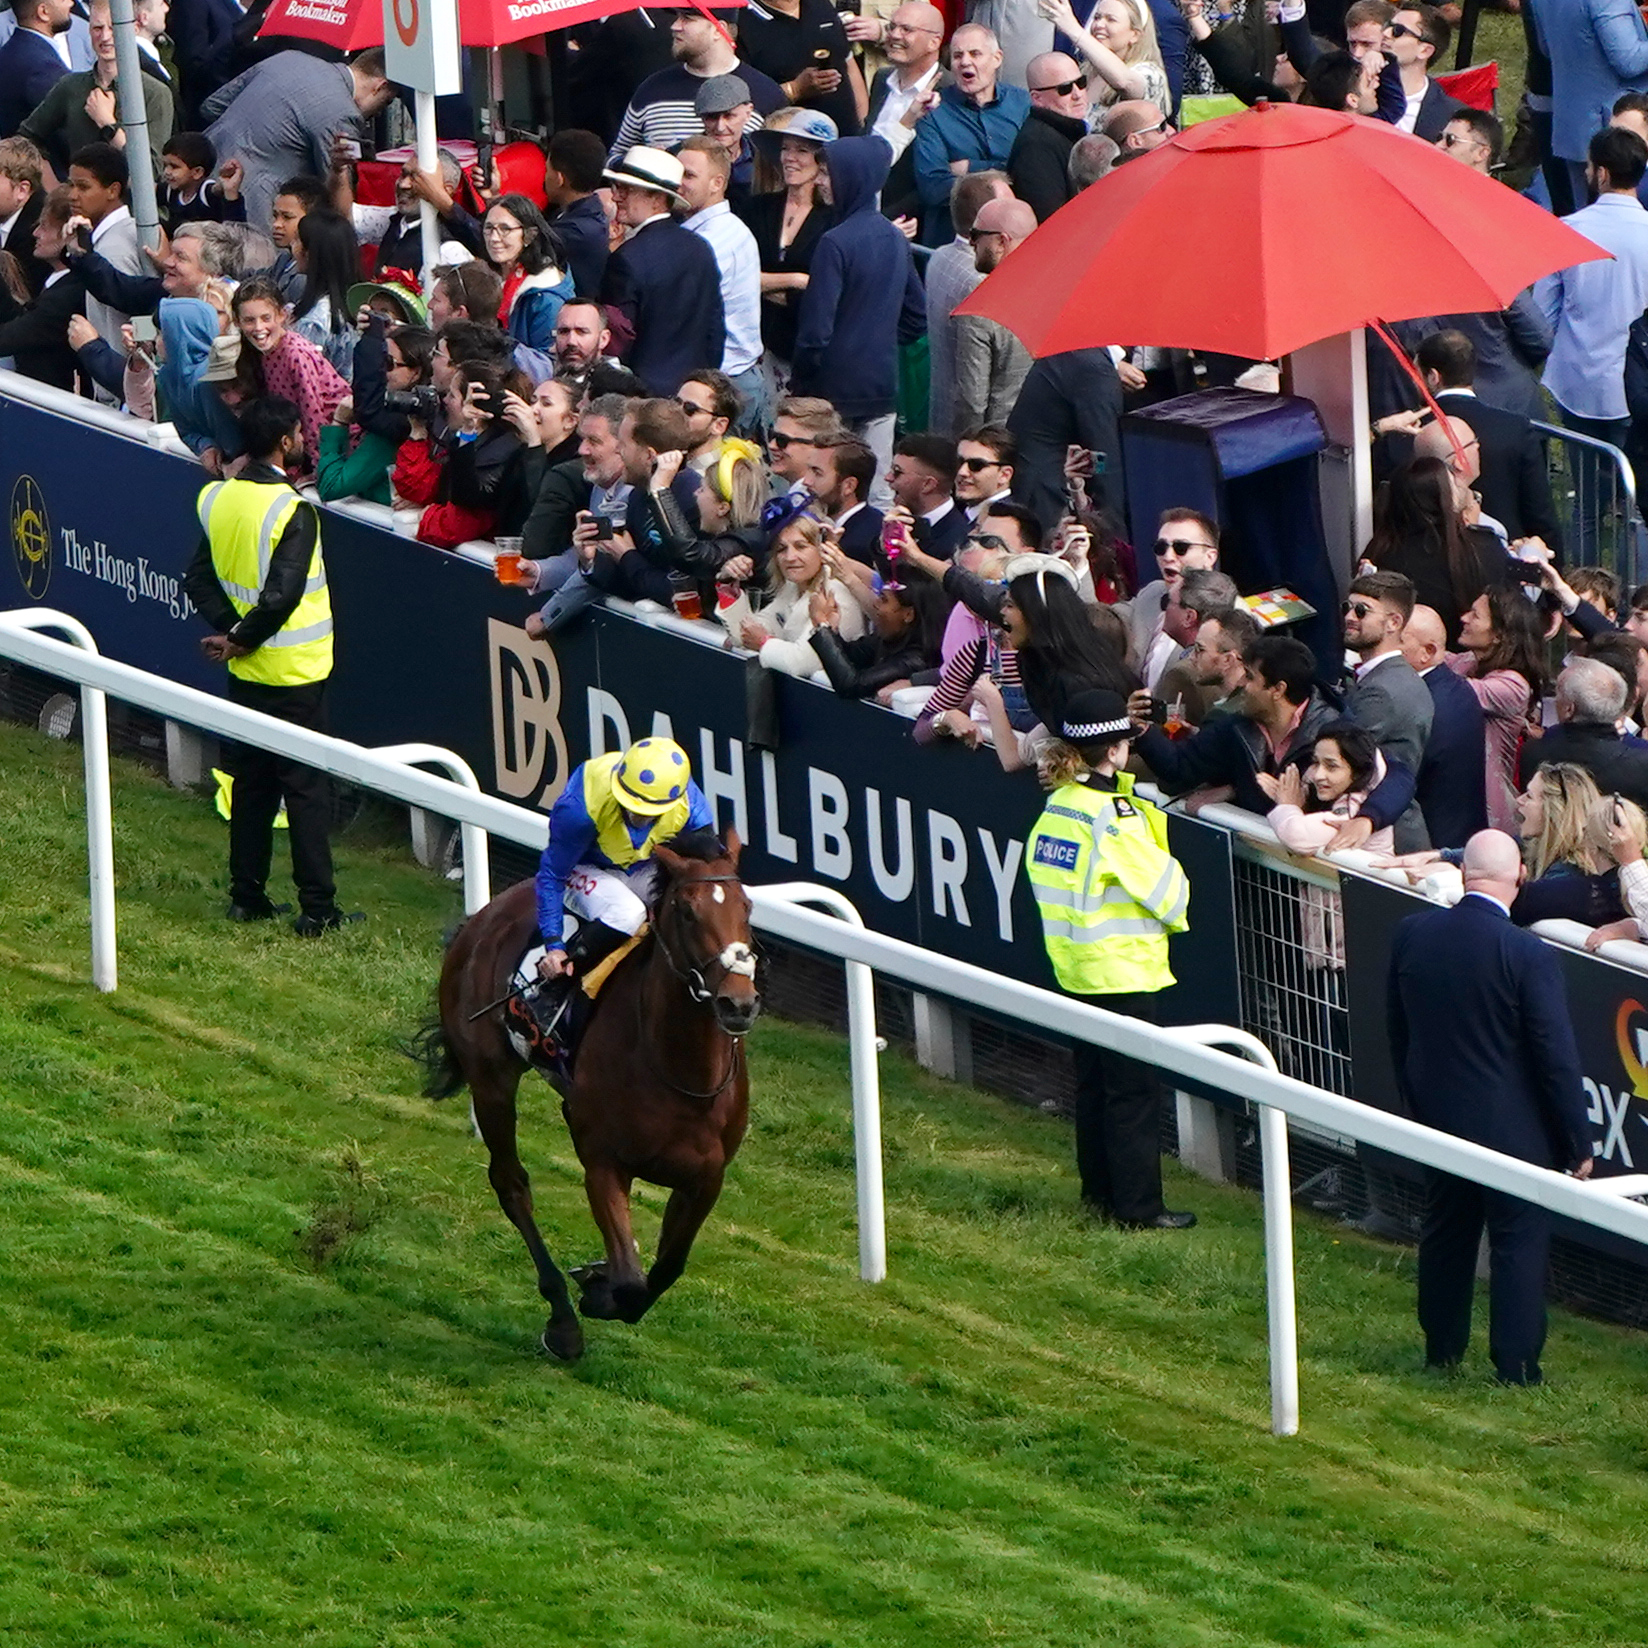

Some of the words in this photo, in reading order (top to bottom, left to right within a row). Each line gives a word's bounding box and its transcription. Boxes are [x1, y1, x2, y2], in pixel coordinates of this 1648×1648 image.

[284, 1, 348, 26] Bookmakers
[60, 526, 92, 575] The
[92, 540, 138, 603] Hong
[137, 556, 181, 619] Kong
[1036, 840, 1077, 864] POLICE
